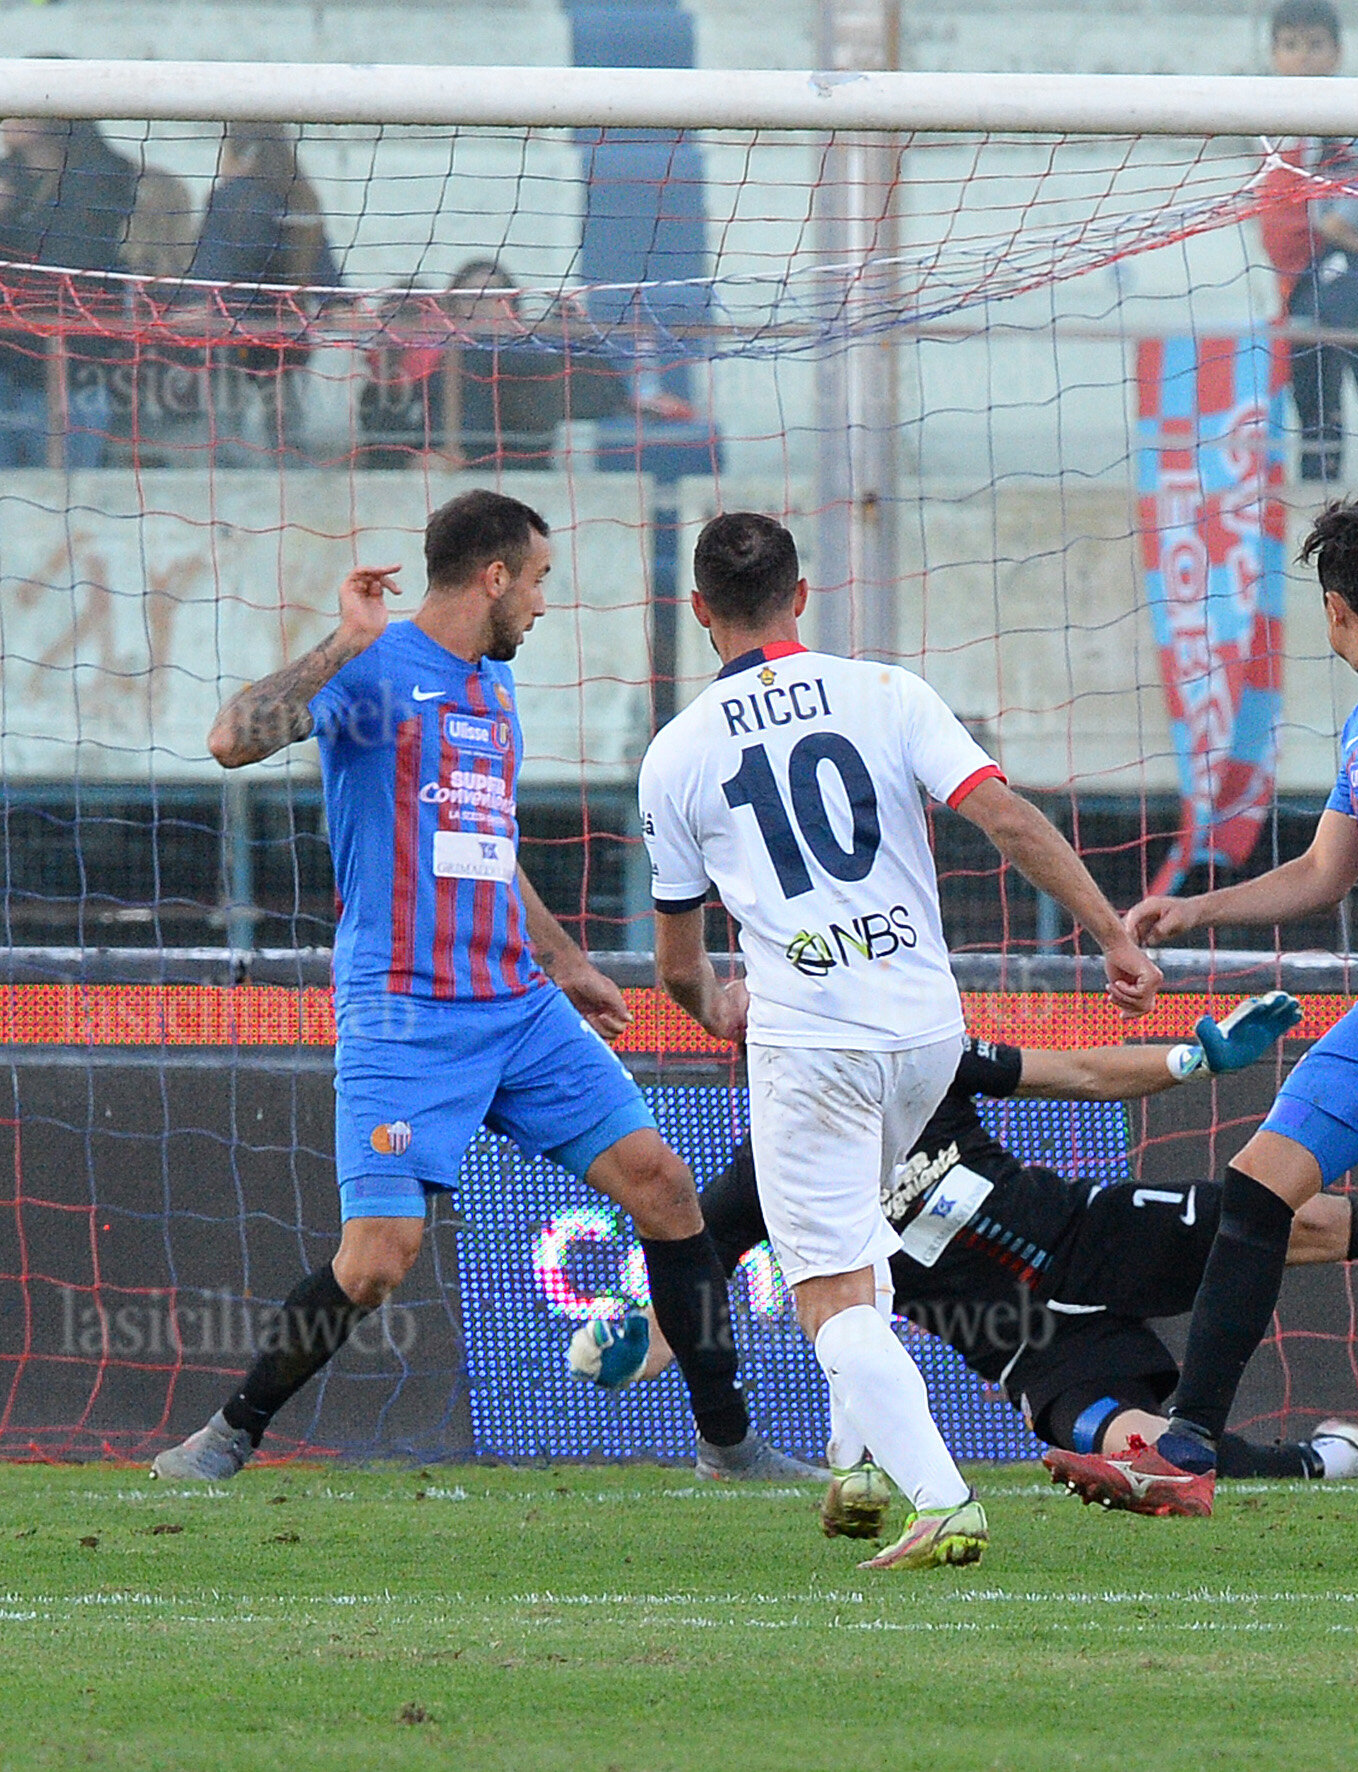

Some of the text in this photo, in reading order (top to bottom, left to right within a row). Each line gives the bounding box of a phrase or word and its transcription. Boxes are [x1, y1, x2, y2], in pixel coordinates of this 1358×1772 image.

[449, 720, 490, 743] Ulisse
[719, 677, 833, 737] RICCI
[721, 731, 882, 901] 10
[832, 904, 918, 968] NBS
